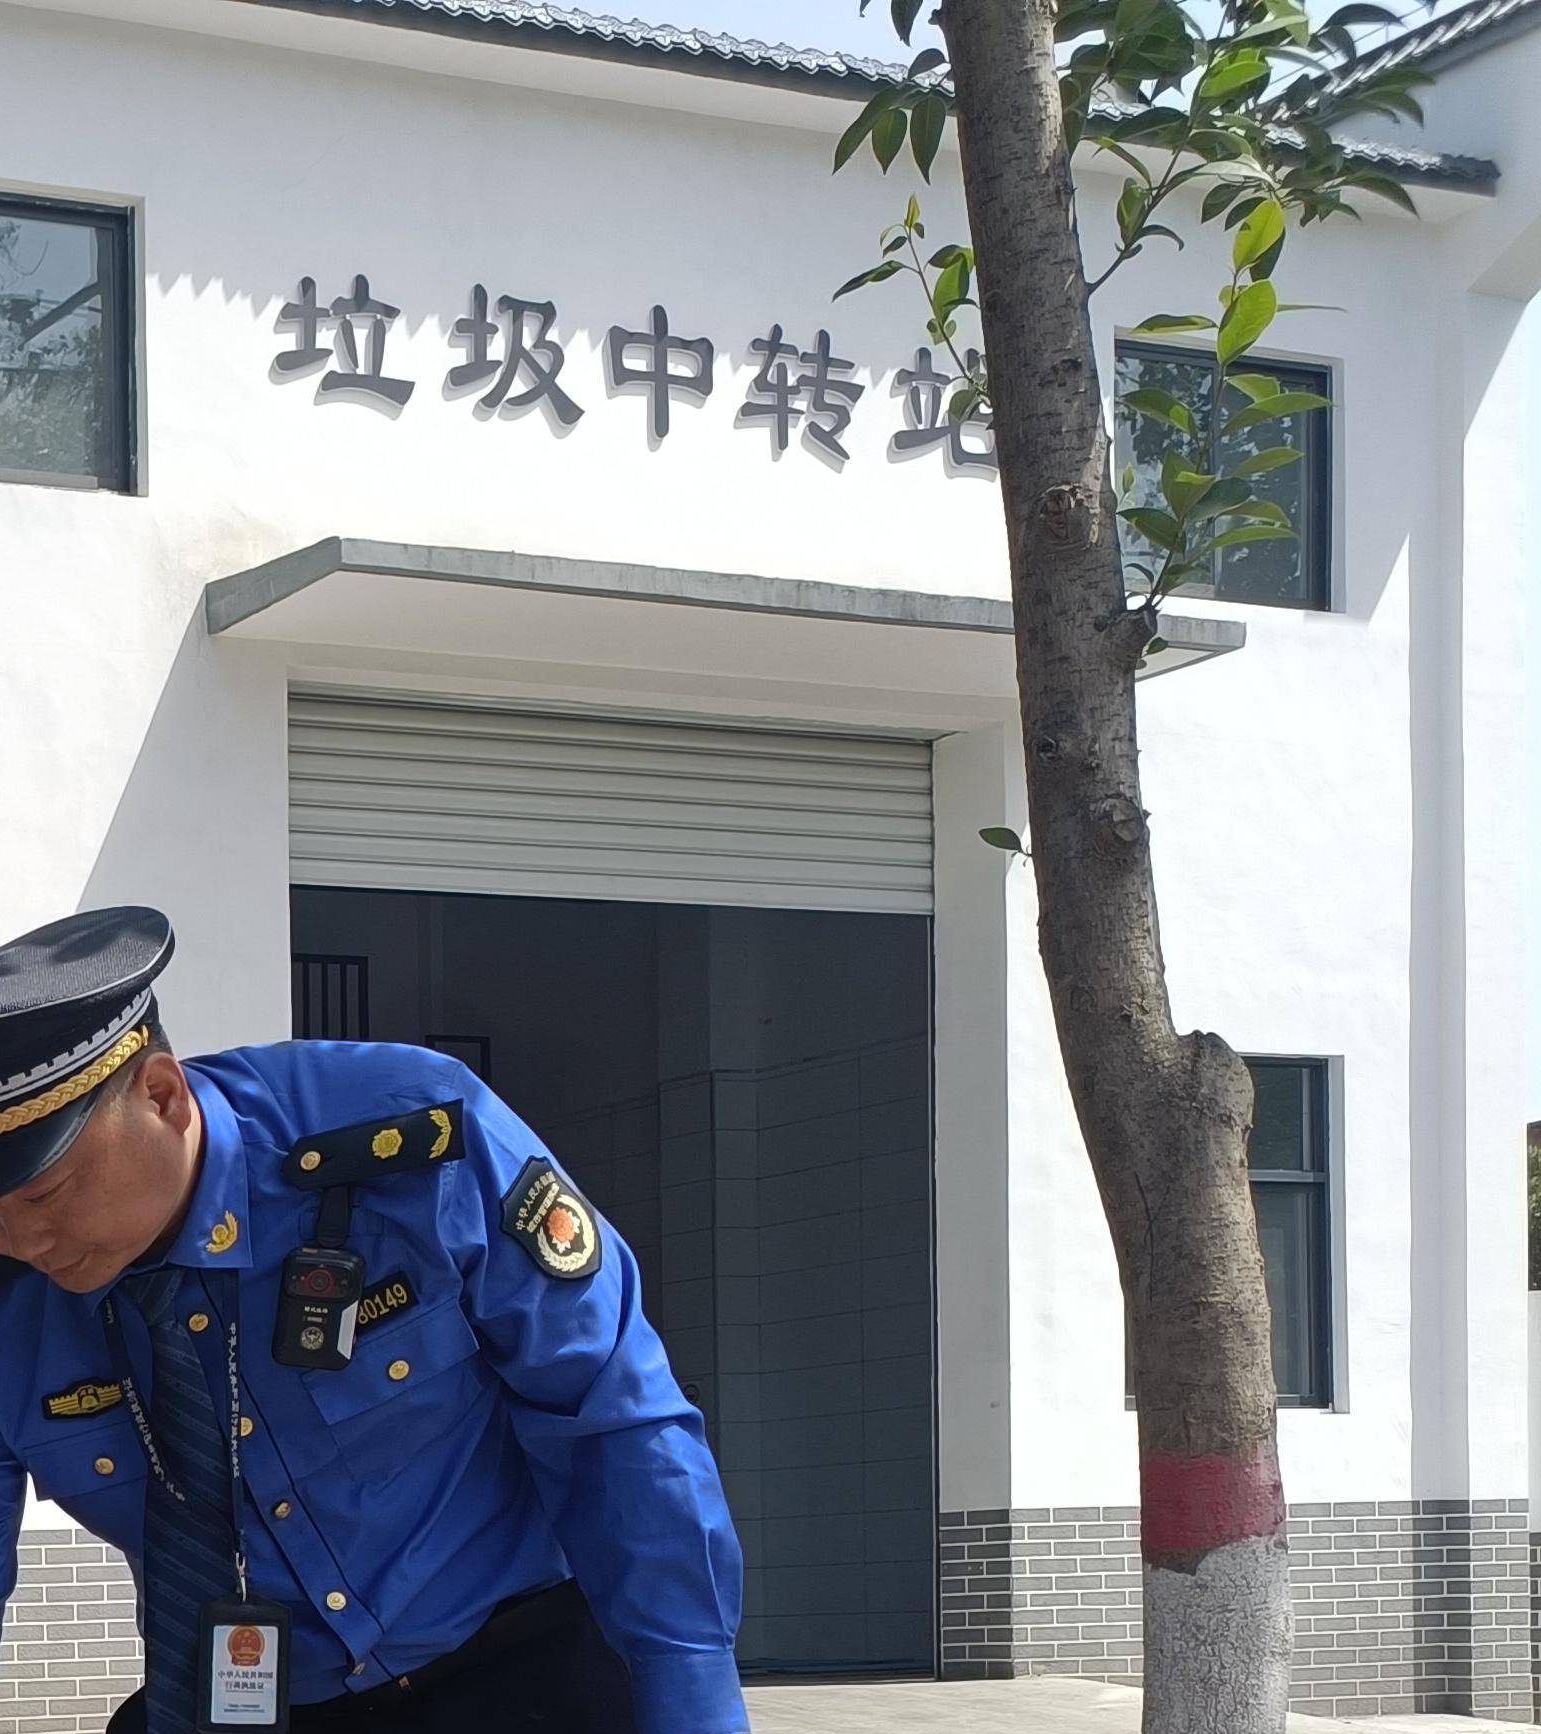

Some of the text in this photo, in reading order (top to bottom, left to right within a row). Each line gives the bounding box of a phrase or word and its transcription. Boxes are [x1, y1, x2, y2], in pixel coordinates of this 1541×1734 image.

[271, 273, 1001, 468] 垃圾中转站
